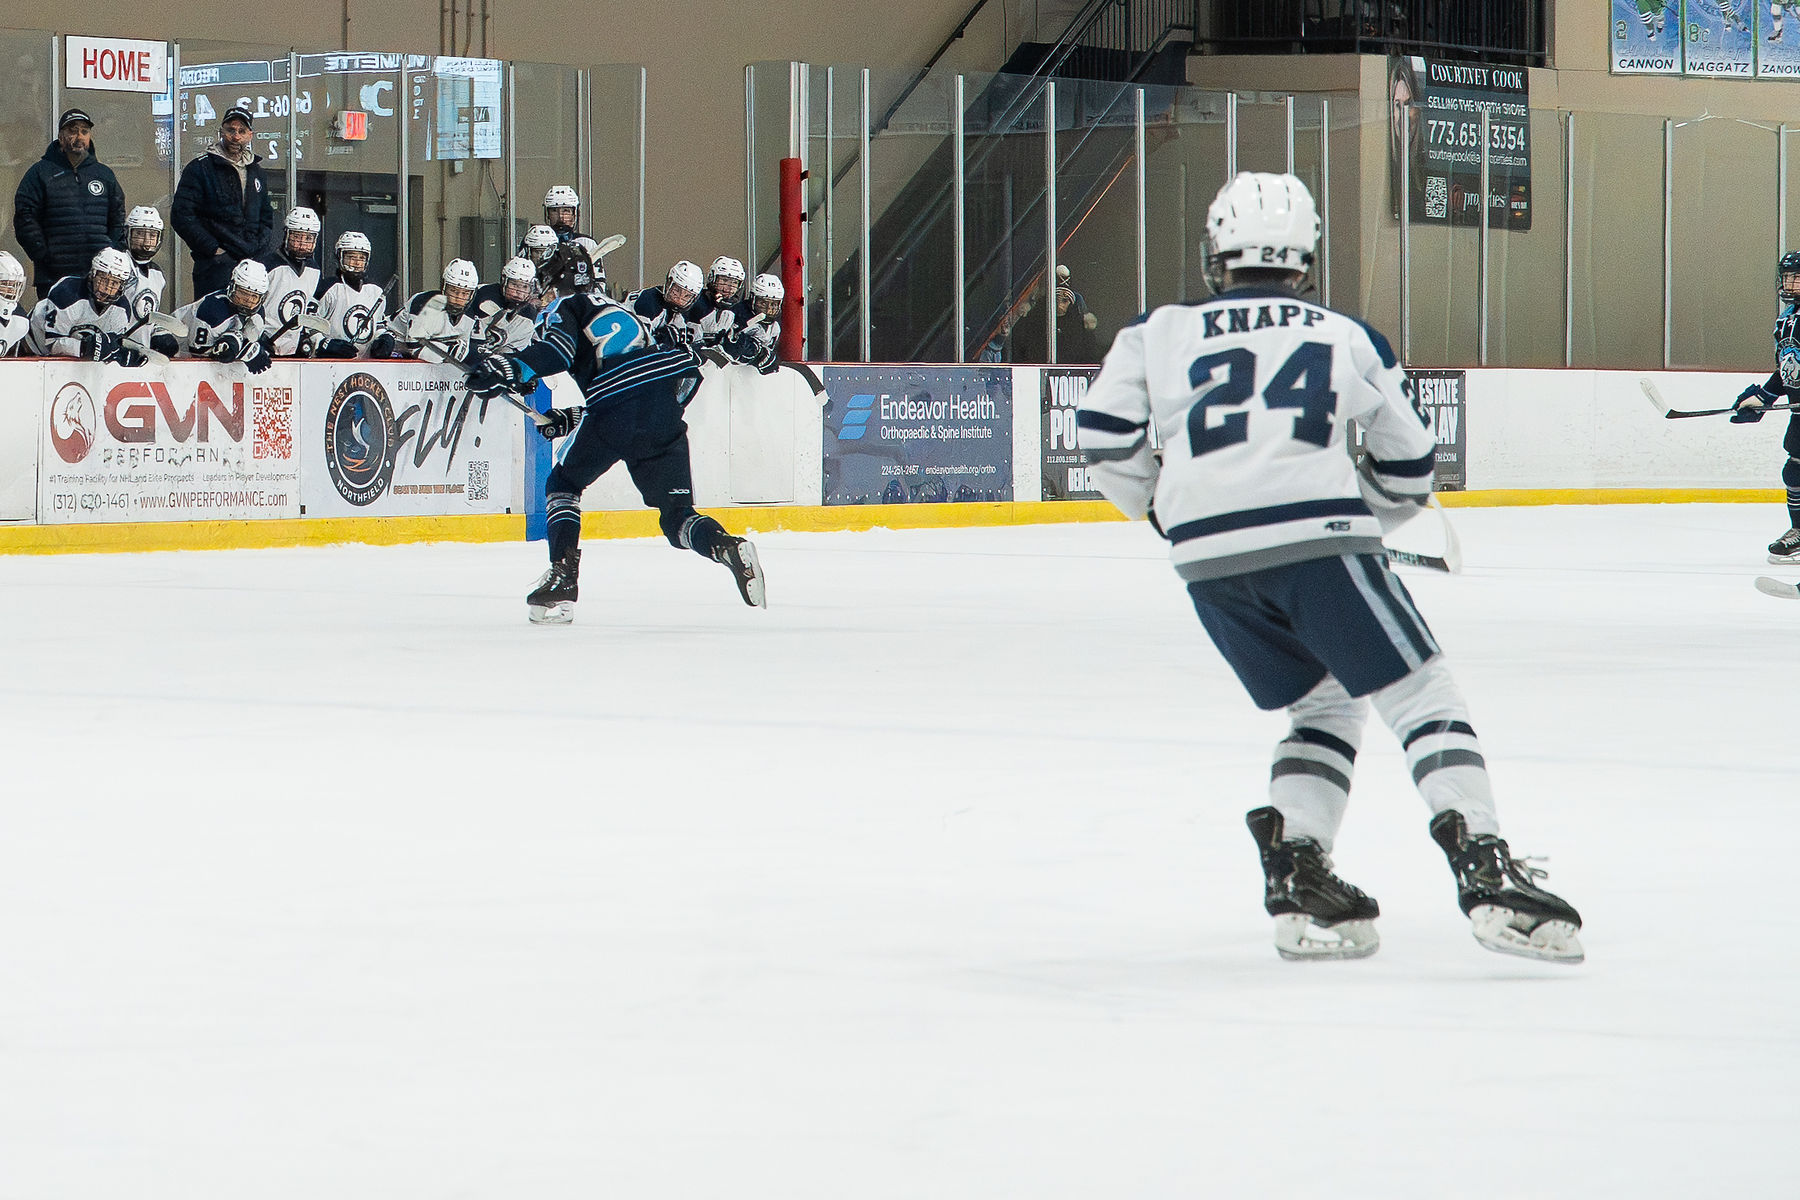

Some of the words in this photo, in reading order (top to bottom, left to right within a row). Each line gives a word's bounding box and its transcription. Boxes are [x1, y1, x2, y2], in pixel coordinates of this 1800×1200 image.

[83, 47, 151, 82] HOME
[1431, 63, 1489, 86] COURTNEY
[1492, 69, 1523, 89] COOK
[1619, 58, 1674, 70] CANNON
[1688, 61, 1750, 73] NAGGATZ
[1428, 95, 1458, 111] SELLING
[1428, 119, 1526, 151] 773.65.3354
[1260, 246, 1289, 264] 24
[1202, 304, 1325, 340] KNAPP
[350, 377, 386, 403] HOCKEY
[398, 381, 424, 392] BUILD,
[1419, 378, 1459, 405] ESTATE
[103, 380, 244, 443] GVN
[880, 394, 947, 421] Endeavor
[950, 395, 995, 420] Health
[1187, 341, 1338, 459] 24
[880, 426, 928, 443] Orthopaedic
[930, 426, 937, 440] &
[938, 427, 960, 442] Spine
[961, 427, 992, 440] Institute
[57, 475, 84, 485] Training
[336, 478, 384, 503] NORTHFIELD
[53, 493, 77, 511] (312)
[140, 491, 288, 509] www.GVNPERFORMANCE.com
